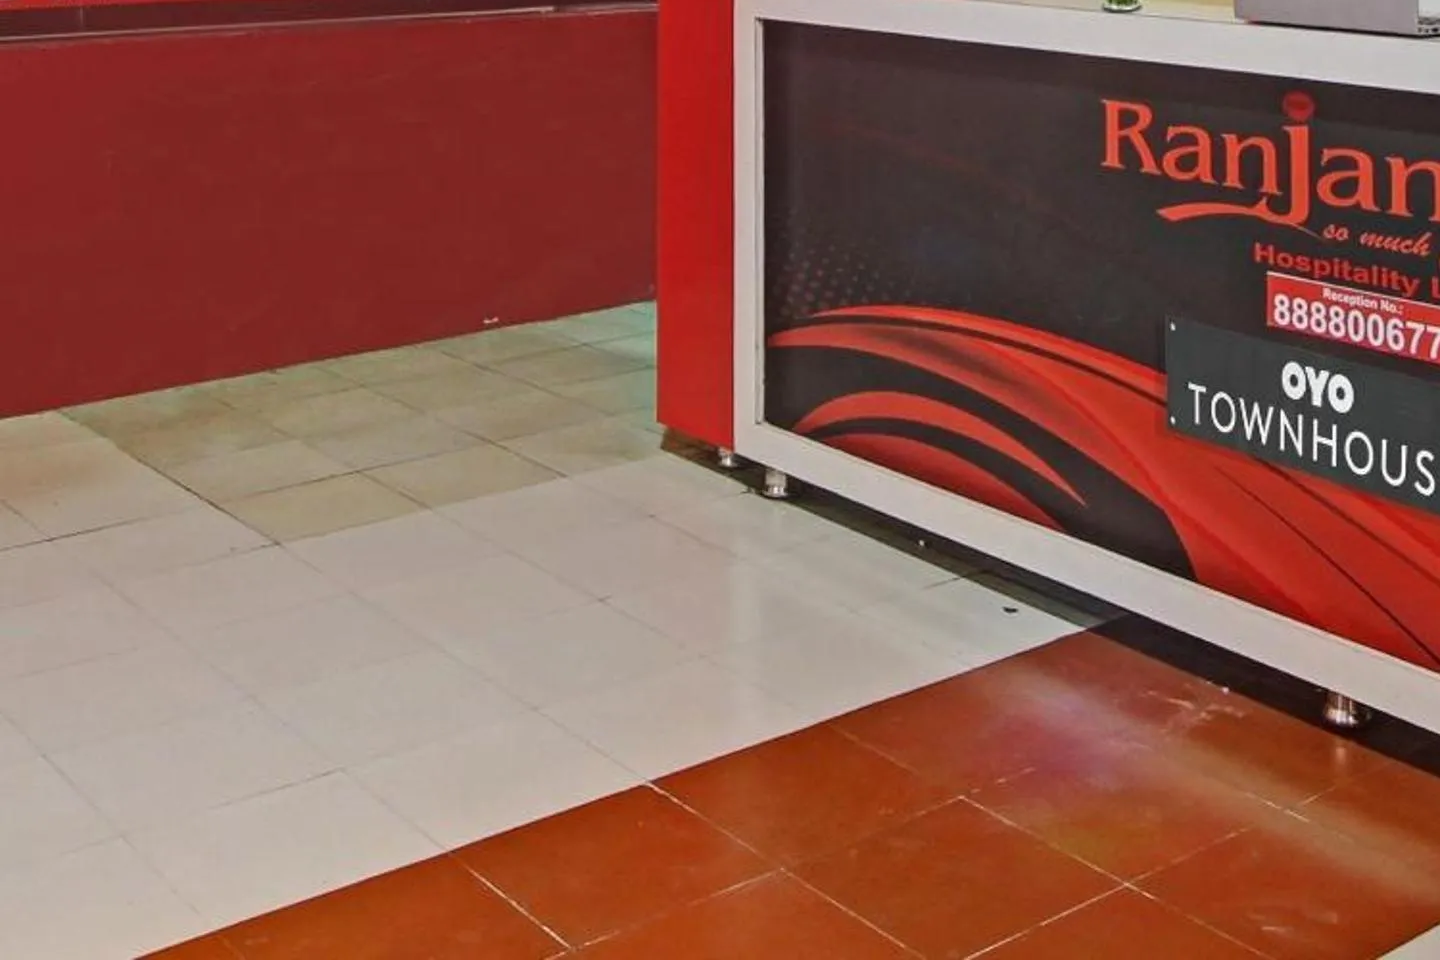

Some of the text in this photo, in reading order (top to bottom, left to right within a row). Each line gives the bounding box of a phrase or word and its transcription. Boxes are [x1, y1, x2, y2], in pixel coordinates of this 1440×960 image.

[1323, 224, 1349, 242] so
[1360, 230, 1431, 257] much
[1253, 241, 1421, 298] Hospitality
[1322, 287, 1378, 310] Reception
[1281, 361, 1354, 414] OYO
